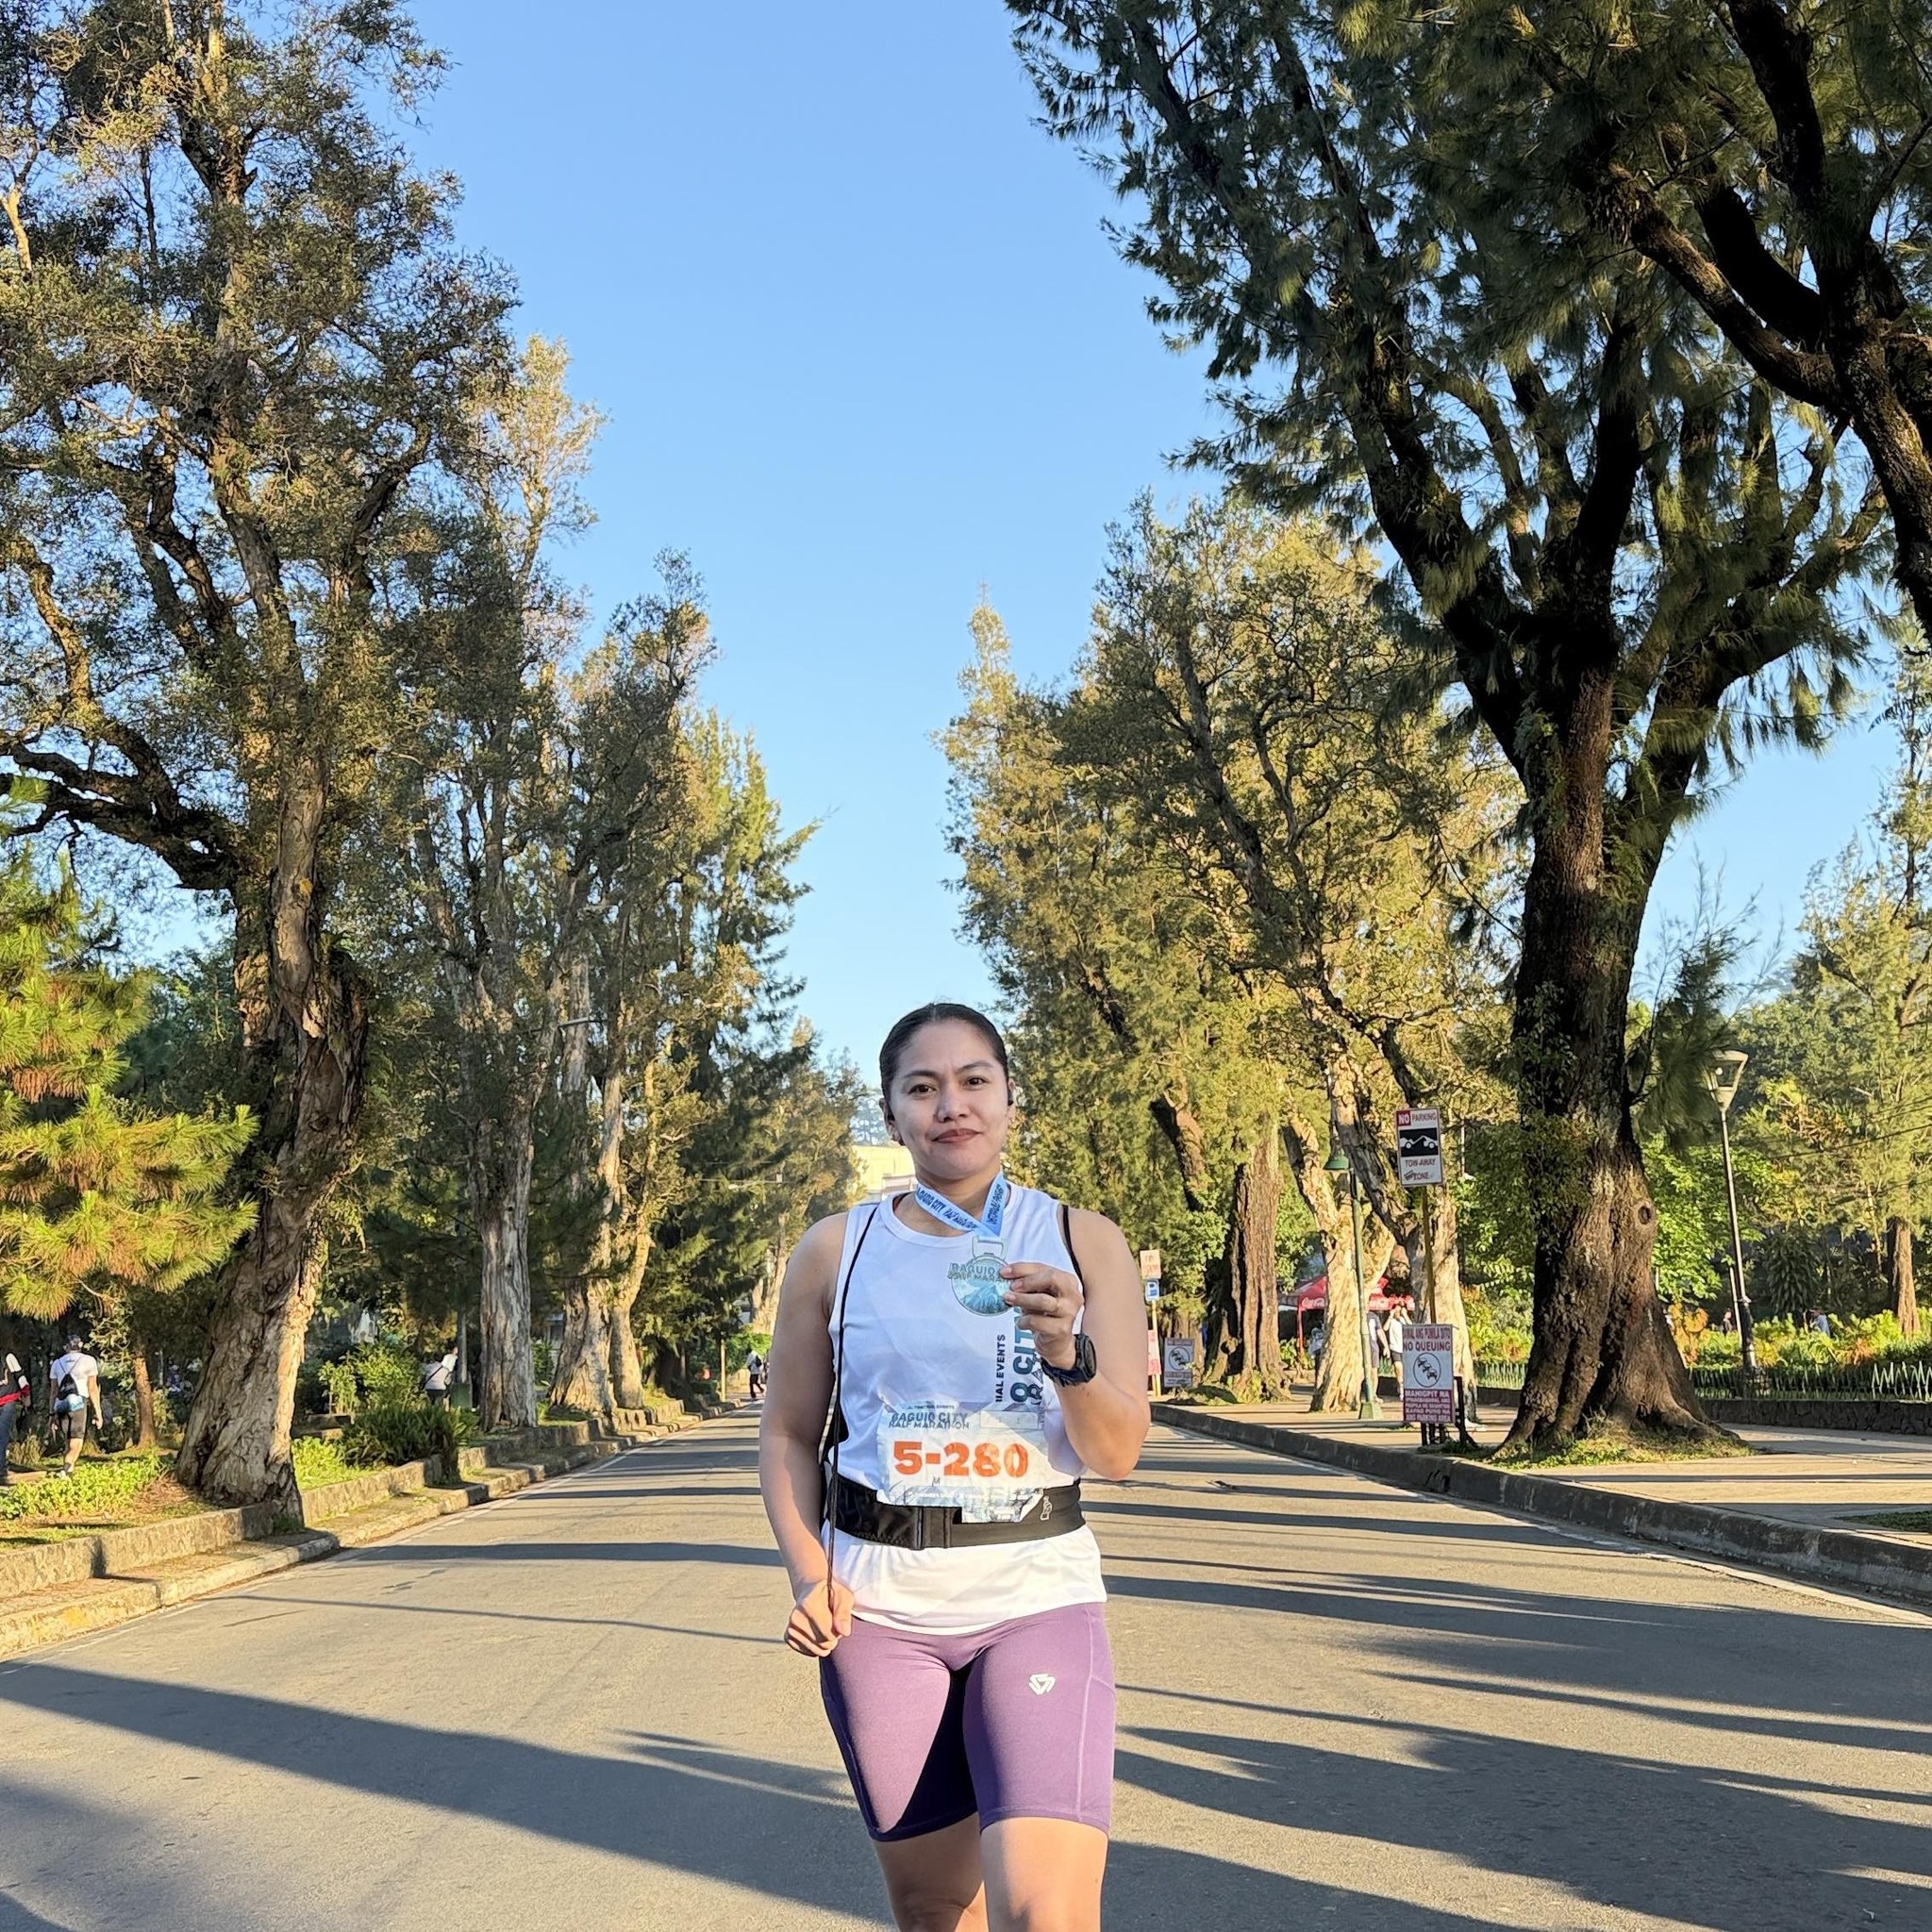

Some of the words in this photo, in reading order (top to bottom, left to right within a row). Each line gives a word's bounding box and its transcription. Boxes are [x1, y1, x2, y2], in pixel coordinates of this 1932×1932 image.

[1398, 1113, 1409, 1124] NO
[1412, 1112, 1437, 1122] PARKING
[1403, 1341, 1413, 1352] NO
[1415, 1341, 1450, 1352] QUEUING
[995, 1334, 1006, 1378] EVENTS
[891, 1411, 936, 1423] BAGUIO
[938, 1411, 969, 1424] CITY
[888, 1421, 912, 1429] HALF
[913, 1421, 970, 1429] MARATHON
[893, 1441, 1029, 1478] 5-280
